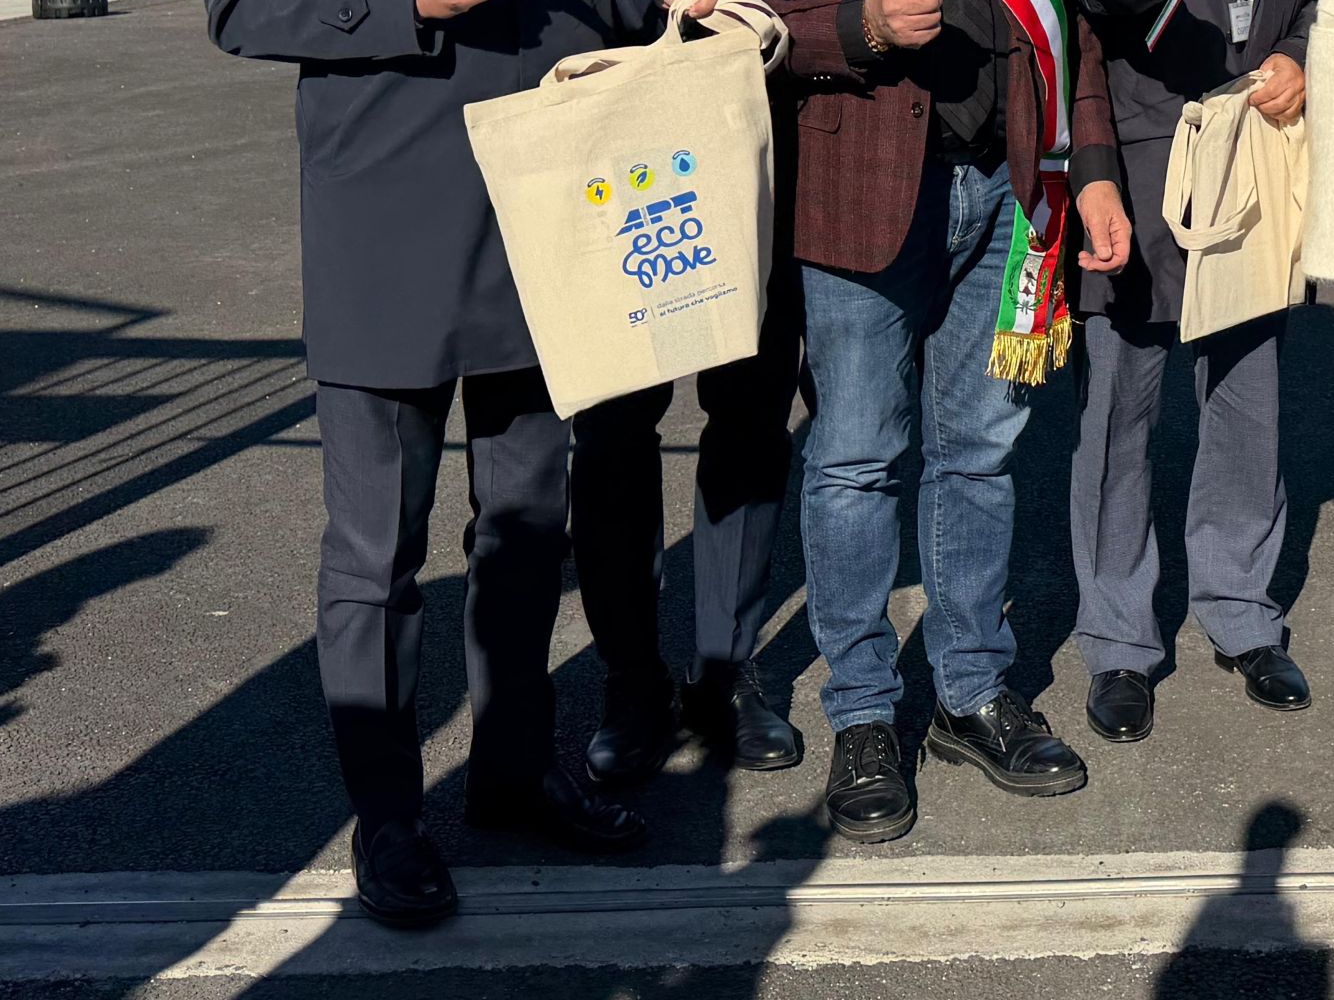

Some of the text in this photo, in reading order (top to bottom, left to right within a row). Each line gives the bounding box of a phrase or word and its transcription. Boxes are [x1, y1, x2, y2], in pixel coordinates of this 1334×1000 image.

[615, 191, 697, 236] APT
[632, 217, 704, 255] eco
[622, 245, 717, 288] move
